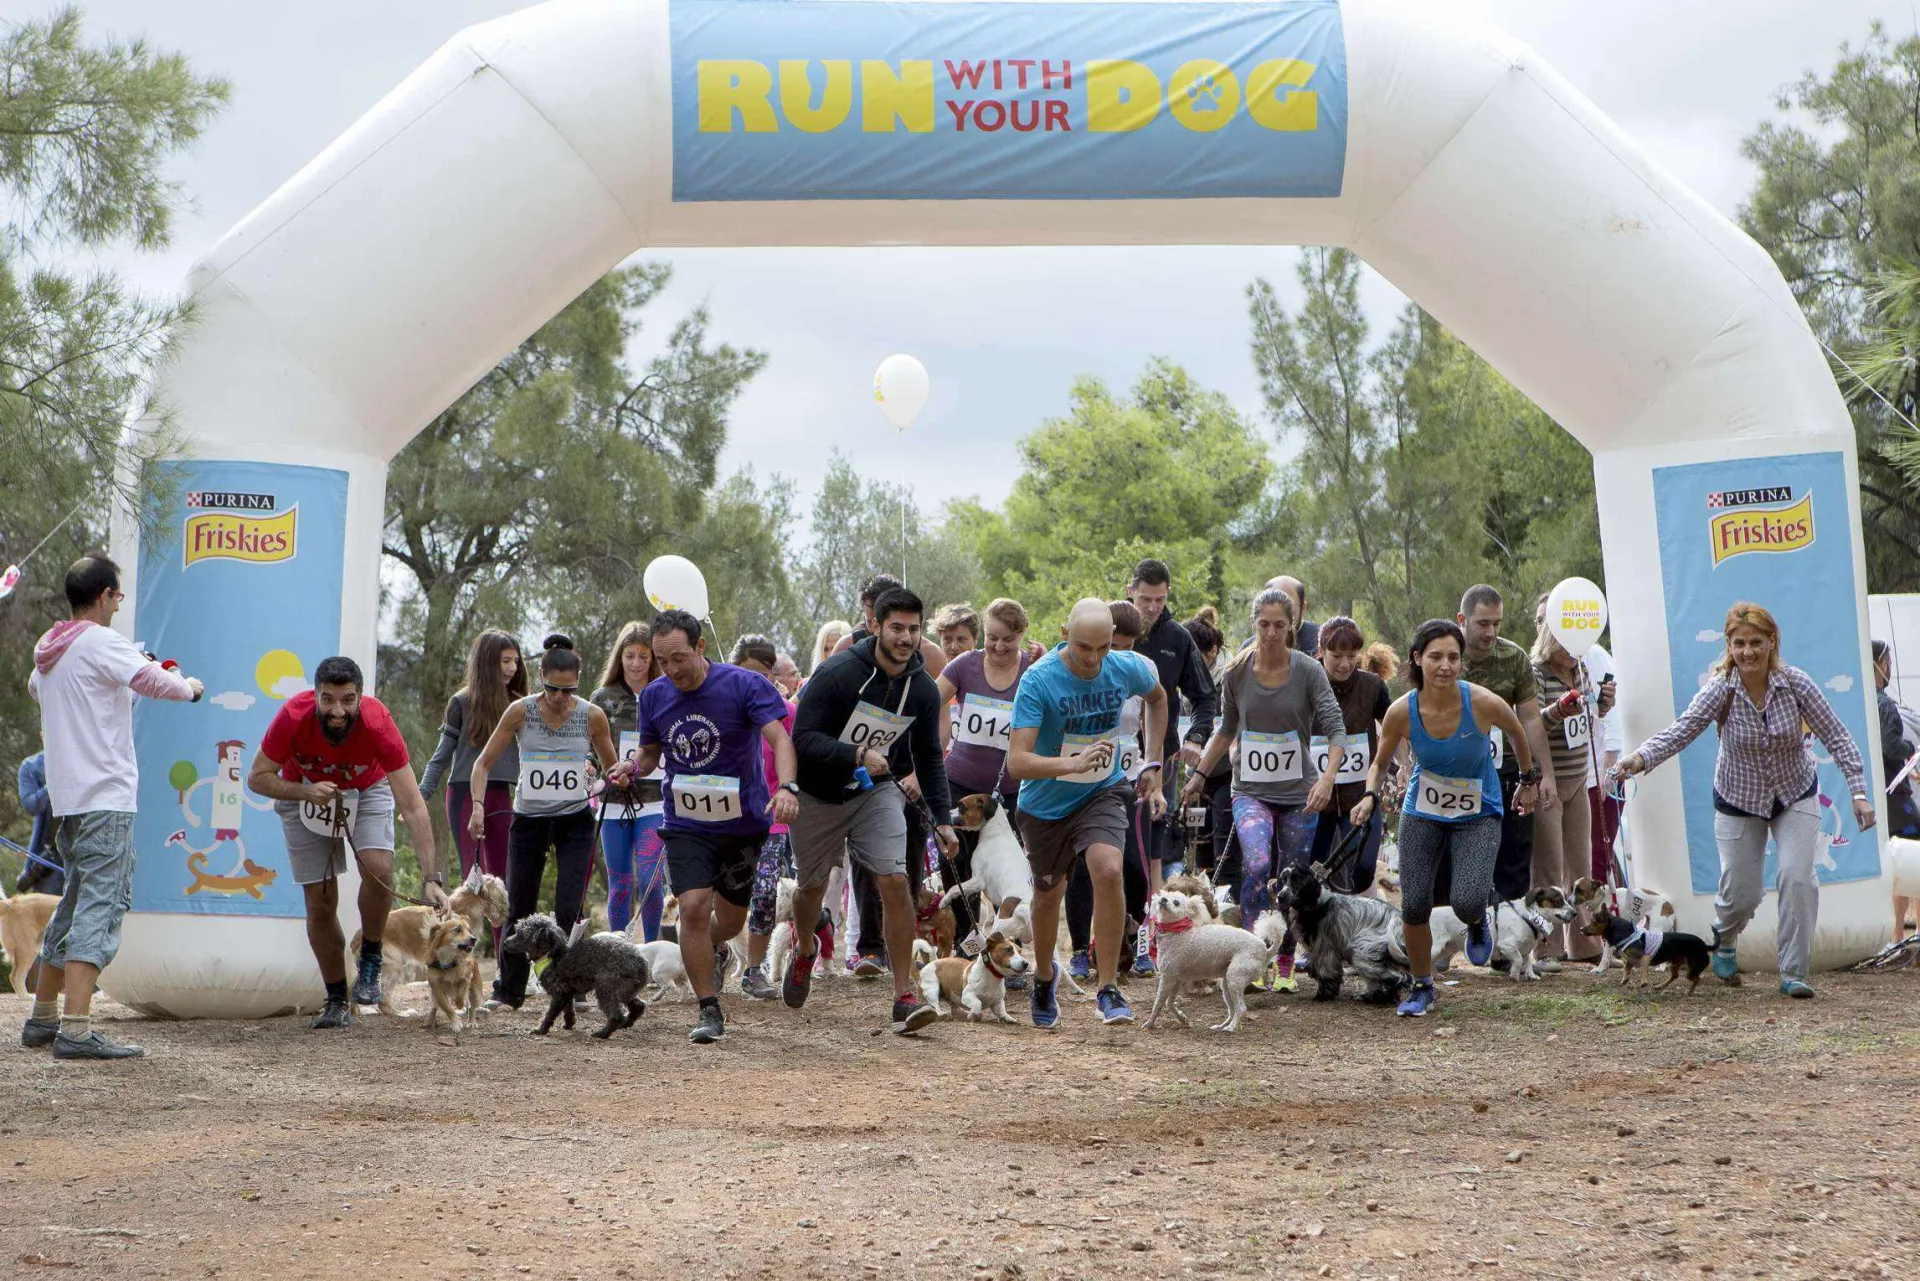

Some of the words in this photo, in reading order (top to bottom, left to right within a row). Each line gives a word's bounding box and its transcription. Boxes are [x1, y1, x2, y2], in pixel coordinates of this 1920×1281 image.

[943, 60, 1072, 90] WITH
[698, 59, 935, 132] RUN
[1086, 58, 1318, 132] DOG
[945, 100, 1072, 132] YOUR
[204, 493, 272, 508] PURINA
[1726, 488, 1789, 505] PURINA
[194, 522, 287, 553] Friskies
[1721, 517, 1807, 550] Friskies
[1059, 688, 1122, 716] SNAKES
[668, 719, 684, 743] ANIMAL
[851, 723, 897, 750] 069
[1248, 750, 1296, 772] 007
[529, 769, 578, 790] 046
[219, 792, 237, 805] 16
[681, 793, 730, 812] 011
[1425, 787, 1475, 811] 025
